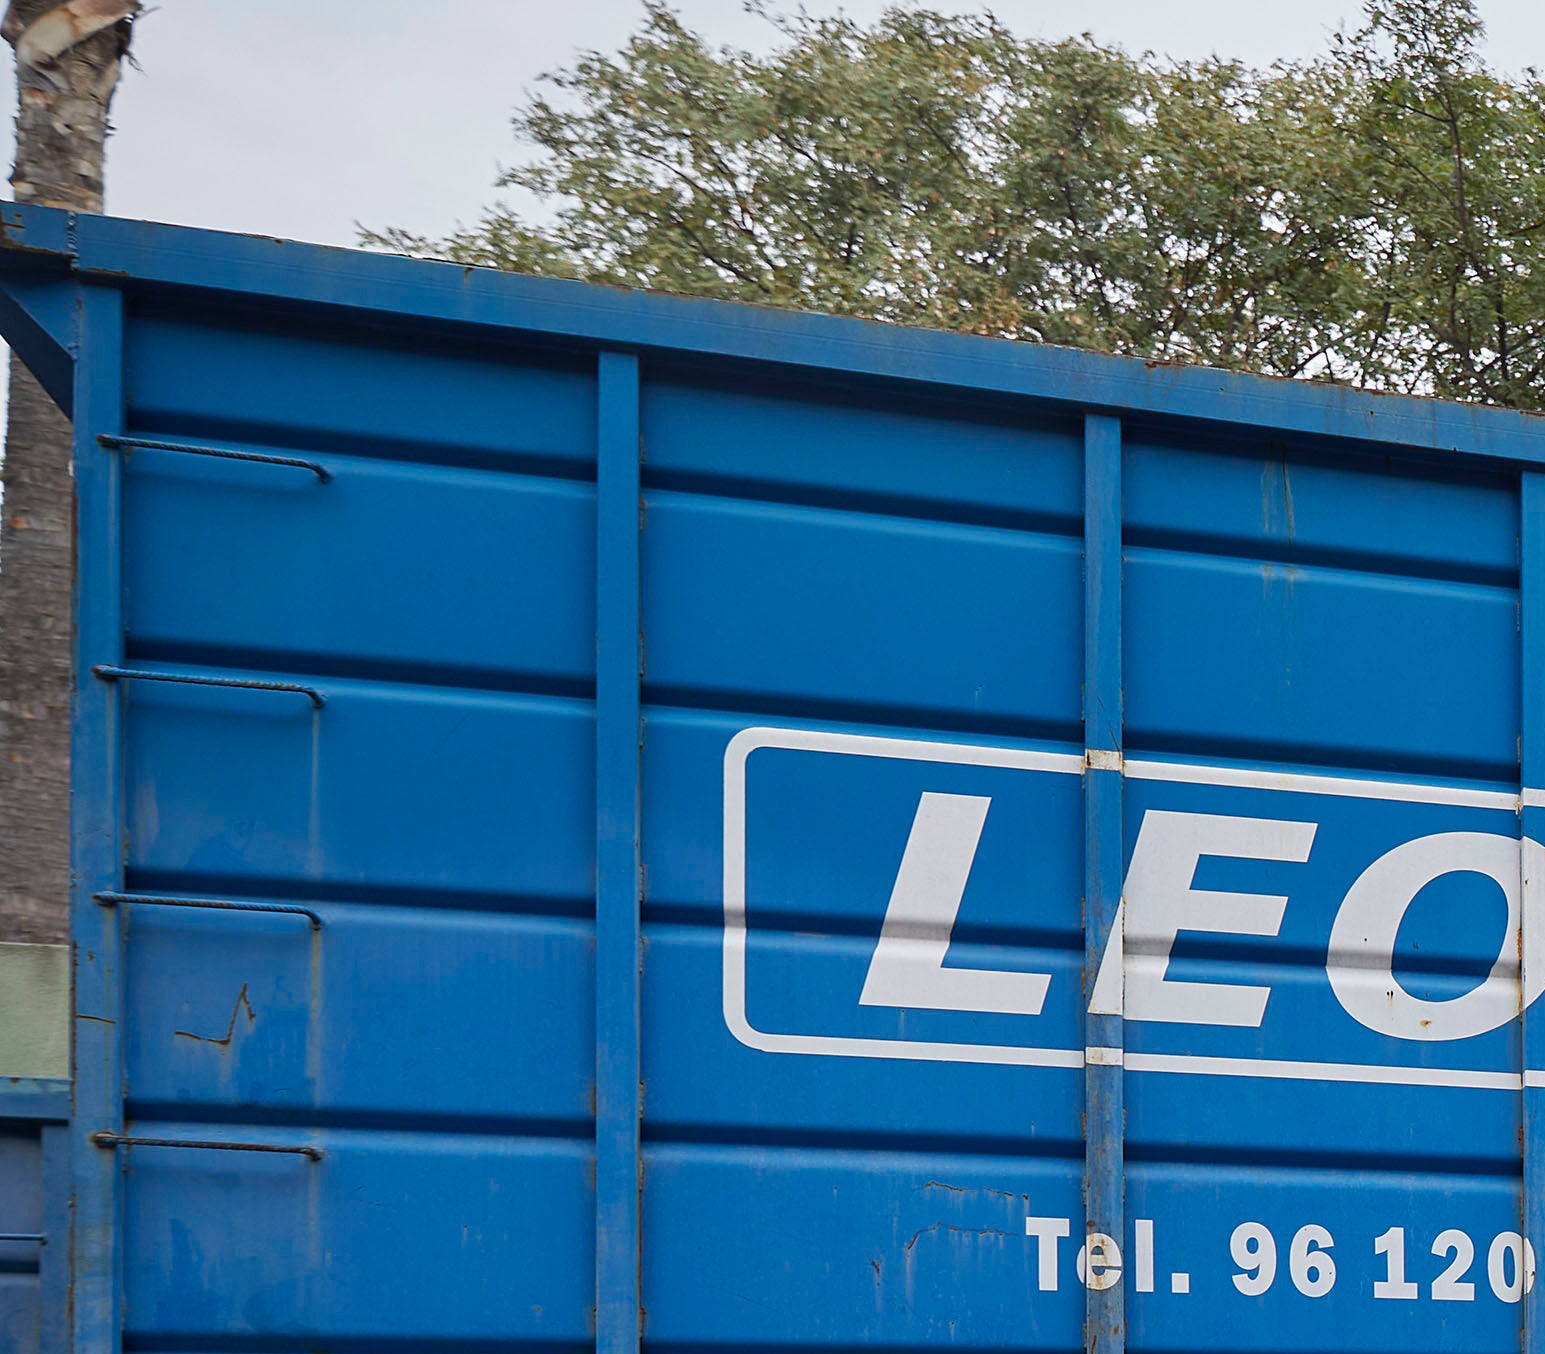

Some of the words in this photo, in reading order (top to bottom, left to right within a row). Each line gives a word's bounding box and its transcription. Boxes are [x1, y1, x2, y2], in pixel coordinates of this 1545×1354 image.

[1026, 1217, 1191, 1295] Tel.
[1230, 1222, 1338, 1299] 96
[1374, 1227, 1537, 1305] 120
